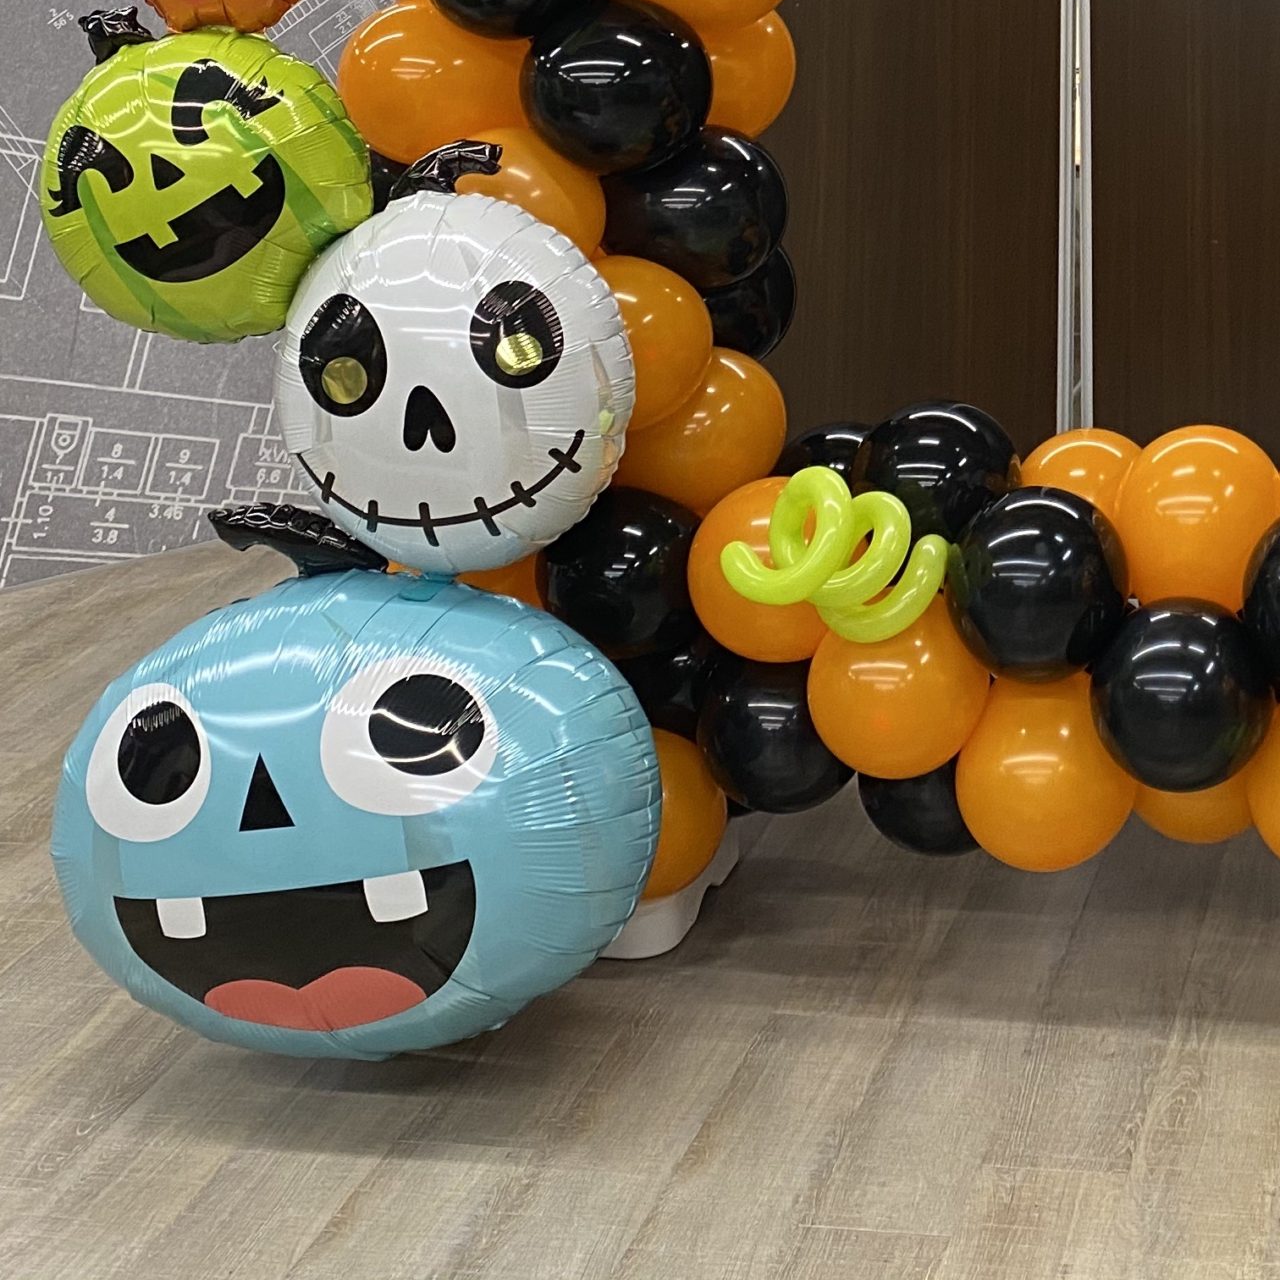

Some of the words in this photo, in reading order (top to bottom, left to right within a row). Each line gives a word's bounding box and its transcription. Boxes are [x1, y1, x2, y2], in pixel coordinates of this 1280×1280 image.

[111, 442, 123, 458] 8
[179, 449, 191, 464] 9
[101, 464, 124, 480] 1.4
[168, 470, 193, 486] 1.4
[104, 506, 116, 523] 4
[91, 528, 119, 545] 3.8
